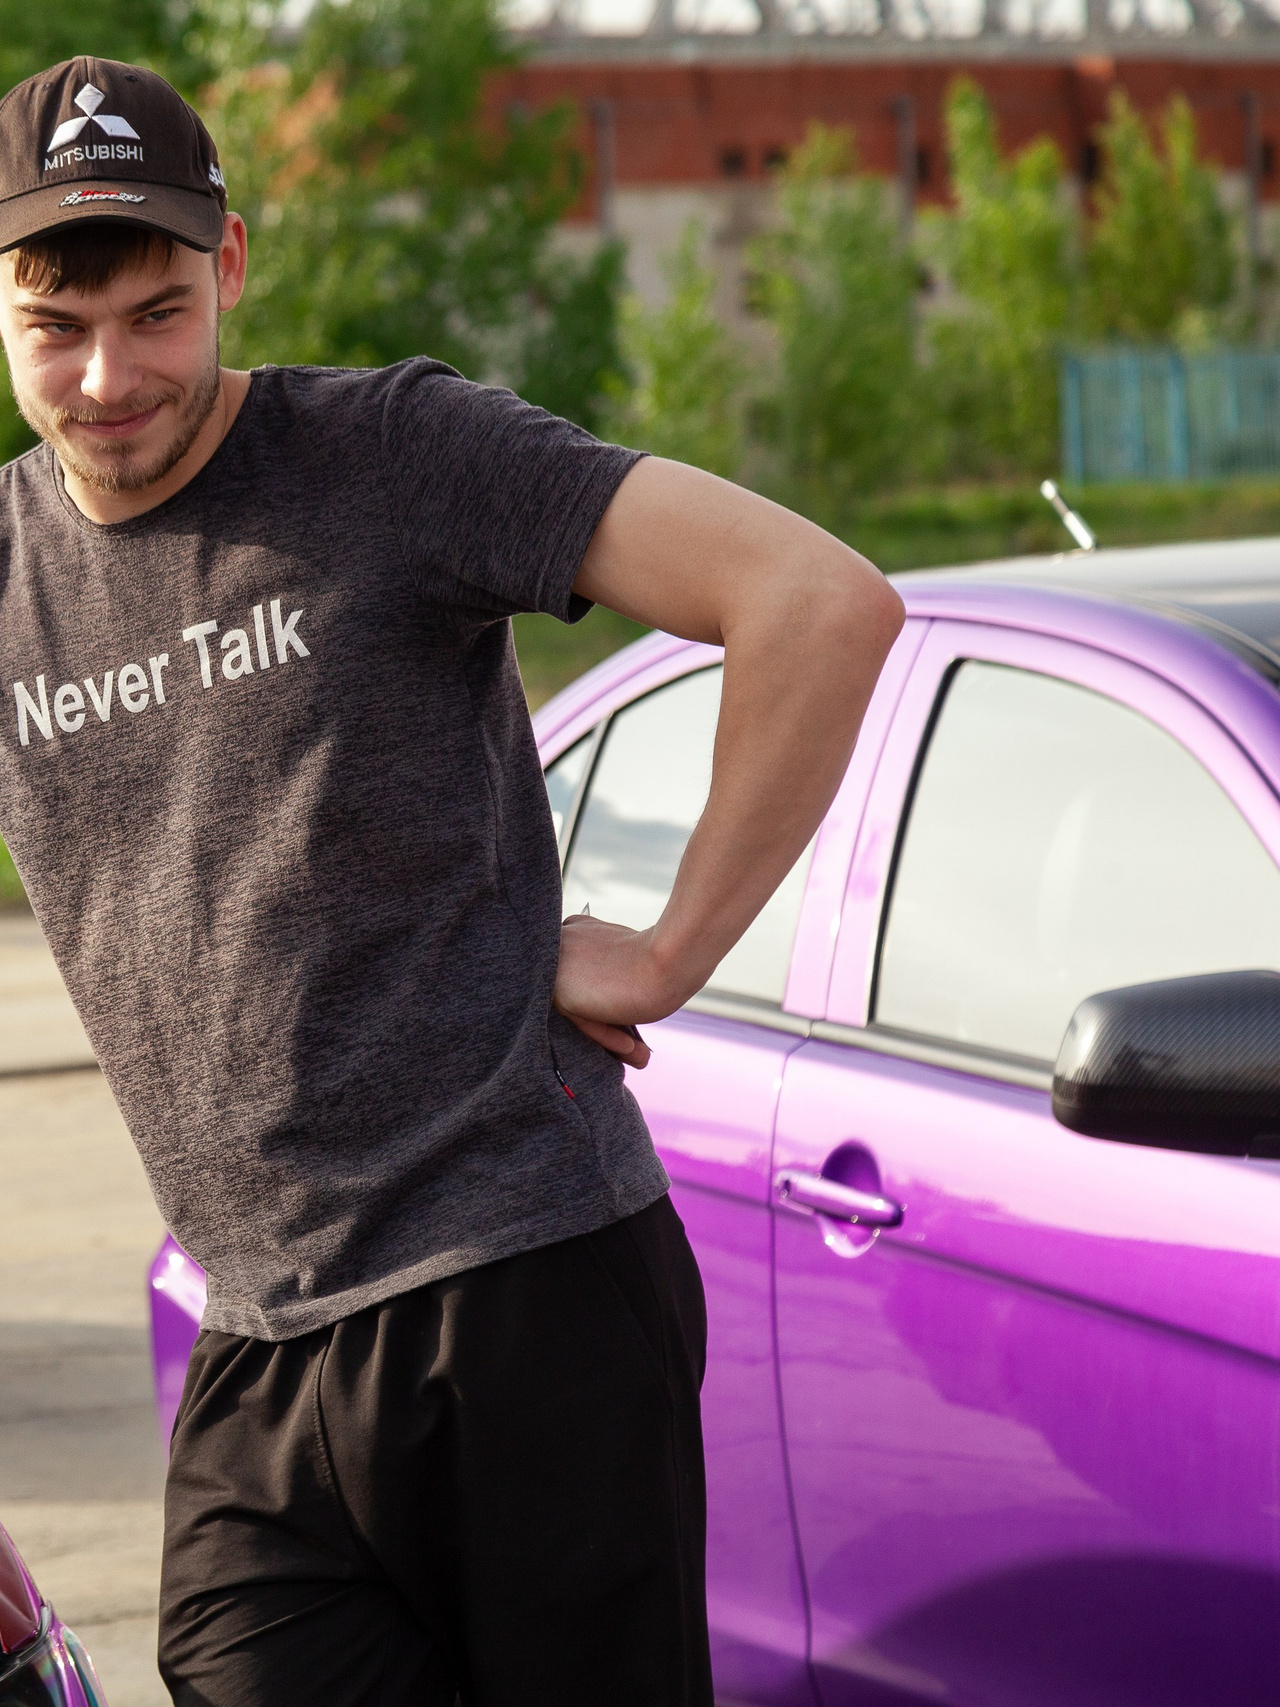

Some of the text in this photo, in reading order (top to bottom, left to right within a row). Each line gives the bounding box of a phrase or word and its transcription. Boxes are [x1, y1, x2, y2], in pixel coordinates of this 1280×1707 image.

[44, 144, 144, 171] MITSUBISHI
[13, 598, 311, 747] Never Talk
